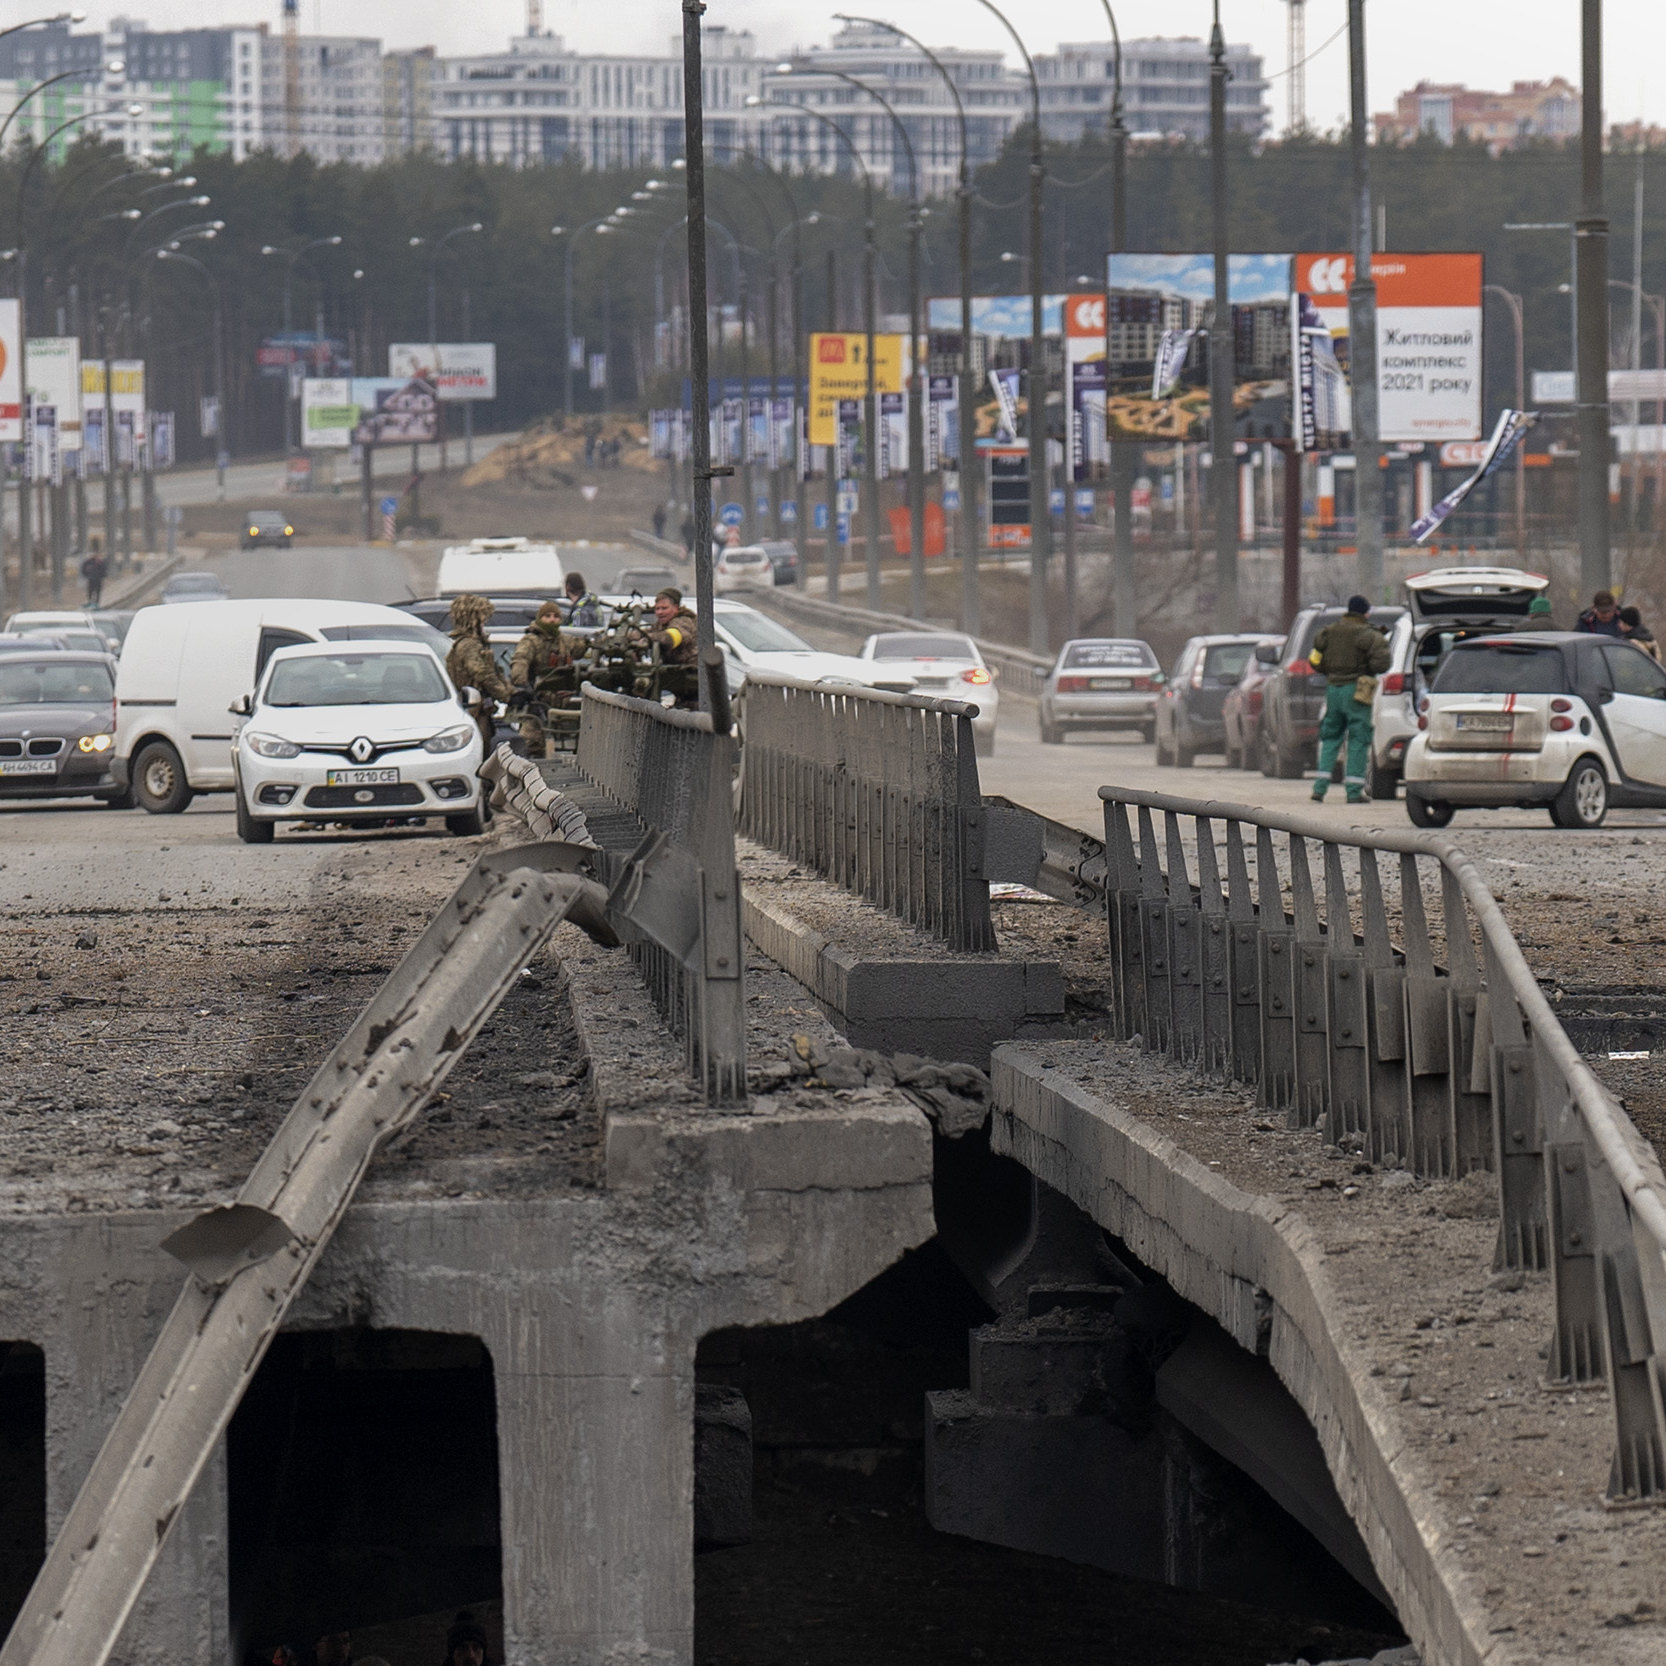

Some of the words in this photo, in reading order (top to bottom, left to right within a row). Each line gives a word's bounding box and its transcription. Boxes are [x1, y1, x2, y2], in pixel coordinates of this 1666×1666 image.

[1383, 330, 1473, 346] Житловий
[1383, 356, 1466, 369] комплекс
[1383, 374, 1423, 390] 2021
[1429, 379, 1472, 394] року
[1303, 392, 1315, 448] ЦЕНТР
[335, 772, 349, 783] AI
[354, 771, 378, 783] 1210
[379, 770, 395, 782] CE
